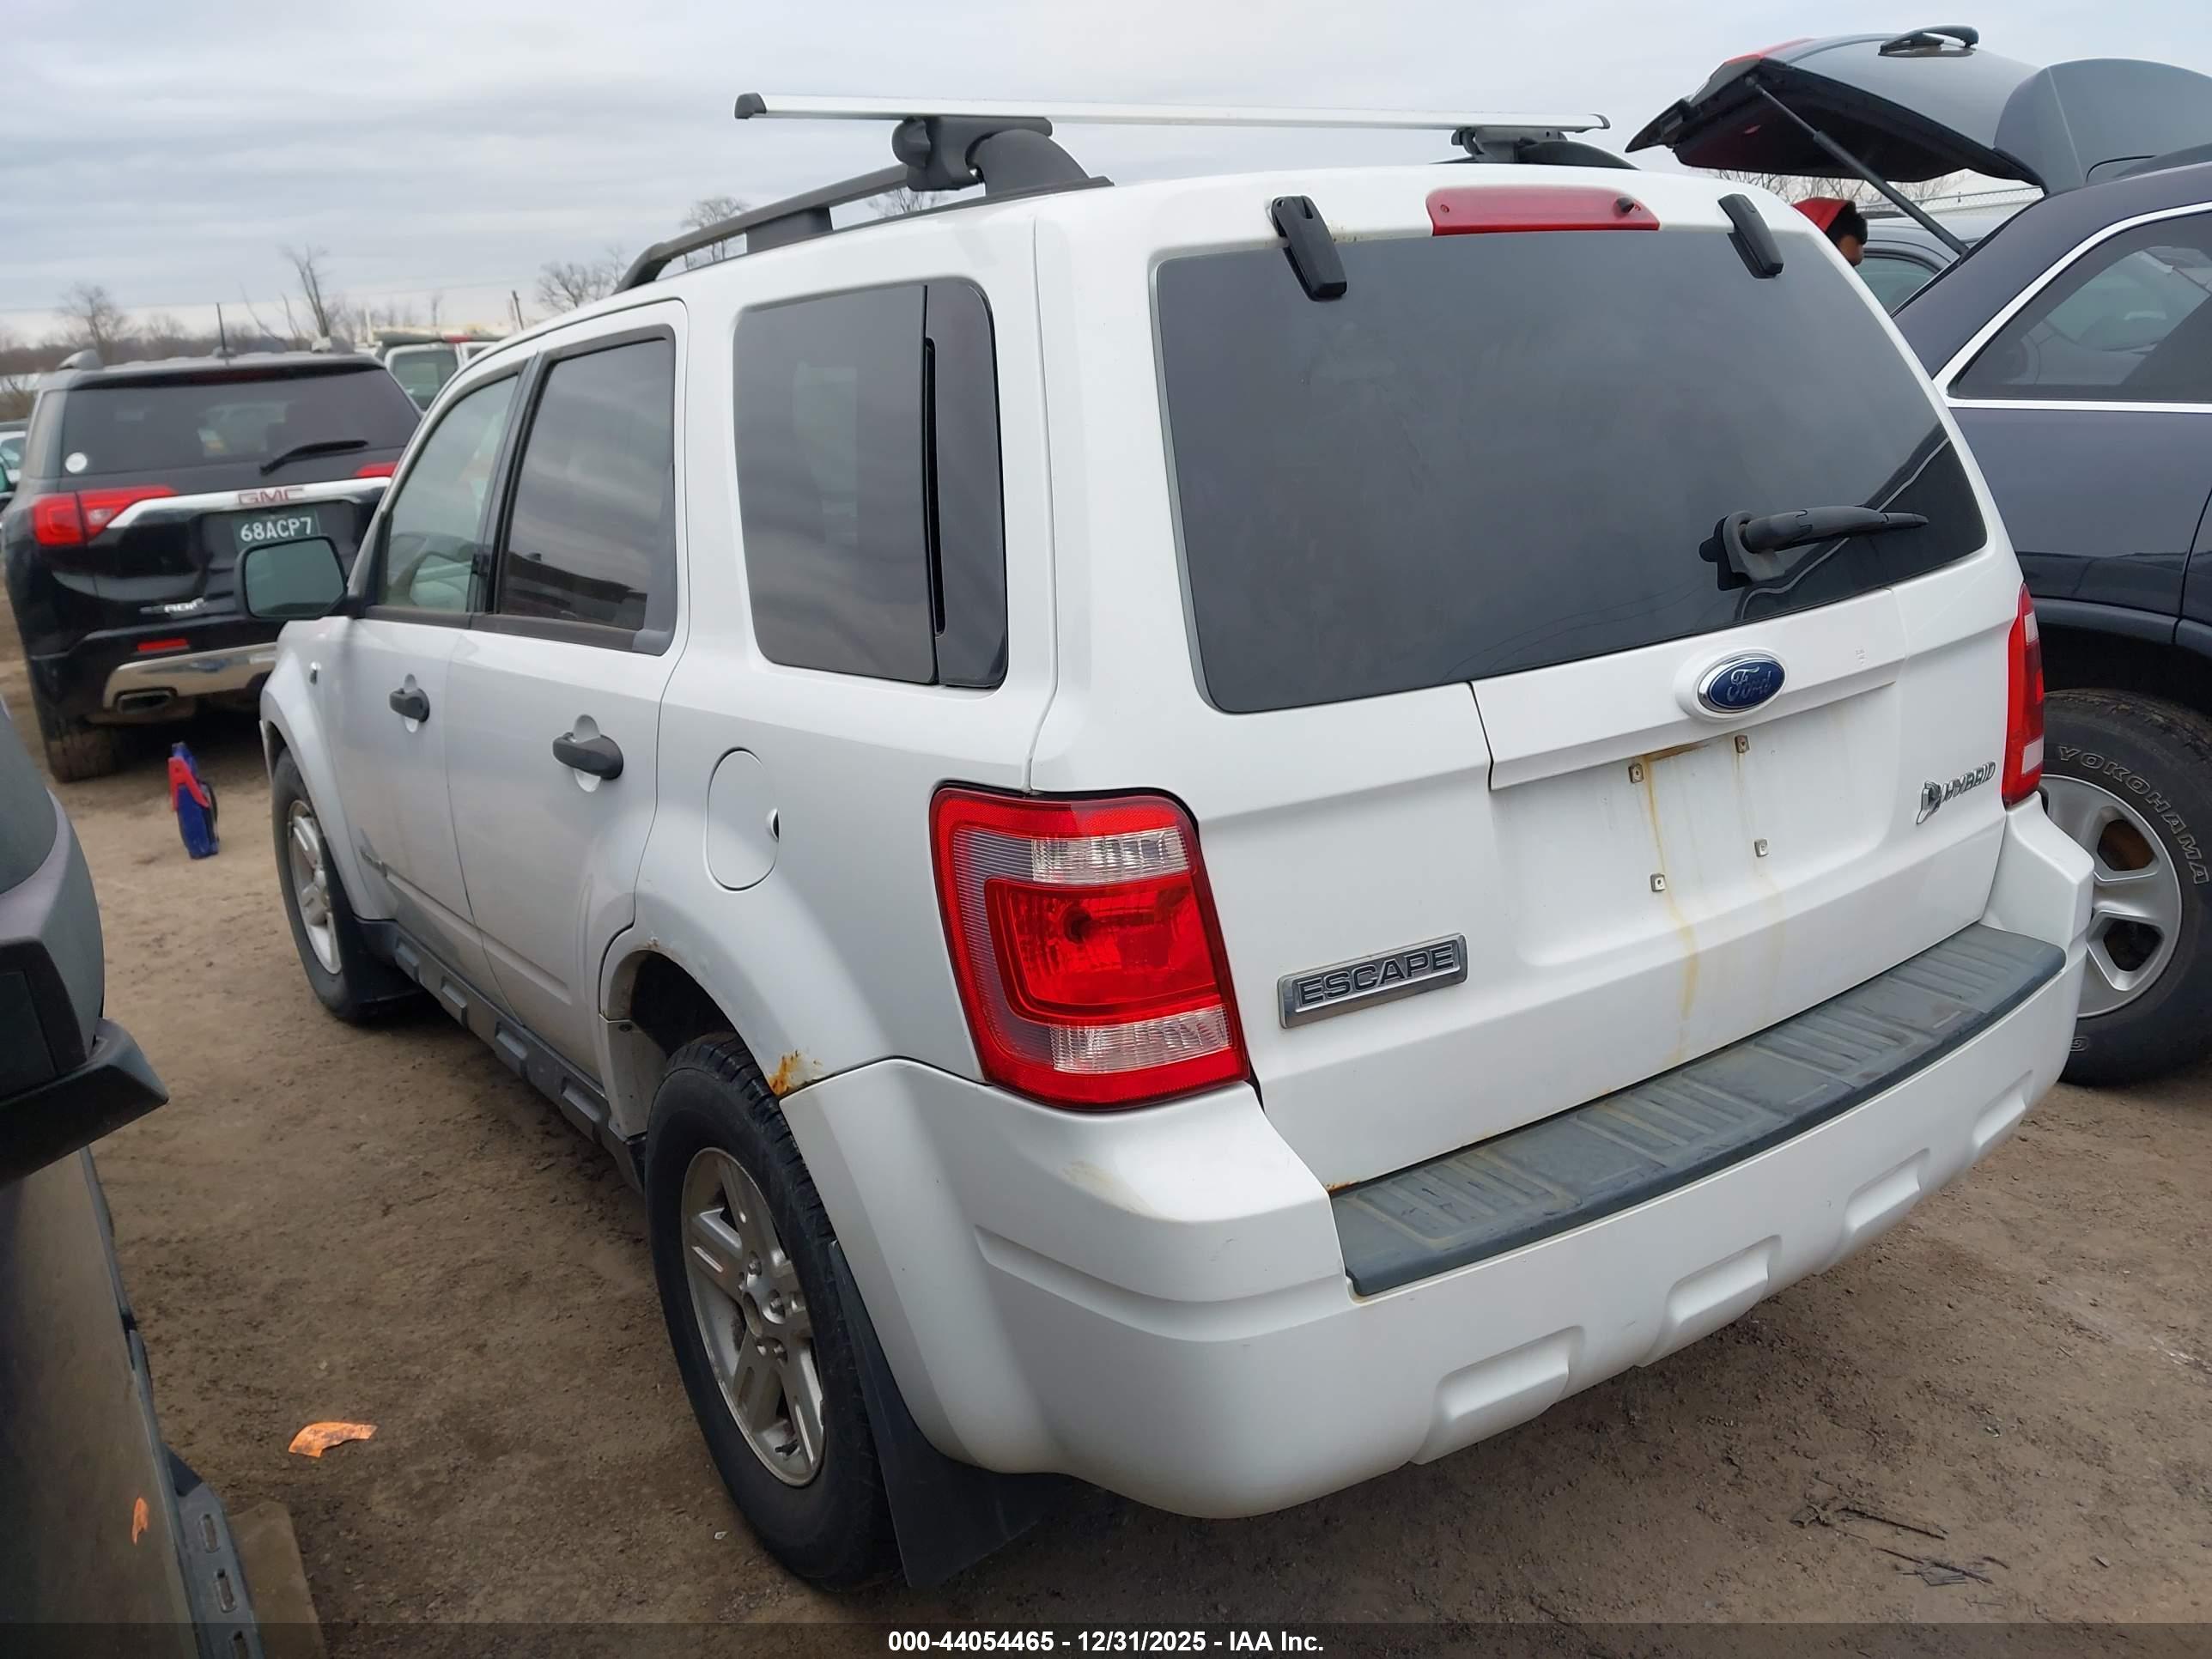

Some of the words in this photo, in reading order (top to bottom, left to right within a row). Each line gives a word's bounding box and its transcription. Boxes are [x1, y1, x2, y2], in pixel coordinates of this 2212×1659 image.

[238, 487, 303, 506] GMC
[240, 517, 312, 542] 68ACP7
[1941, 761, 1996, 803] HYBRID
[2059, 745, 2209, 884] YOKOHAMA
[1297, 943, 1454, 1006] ESCAPE
